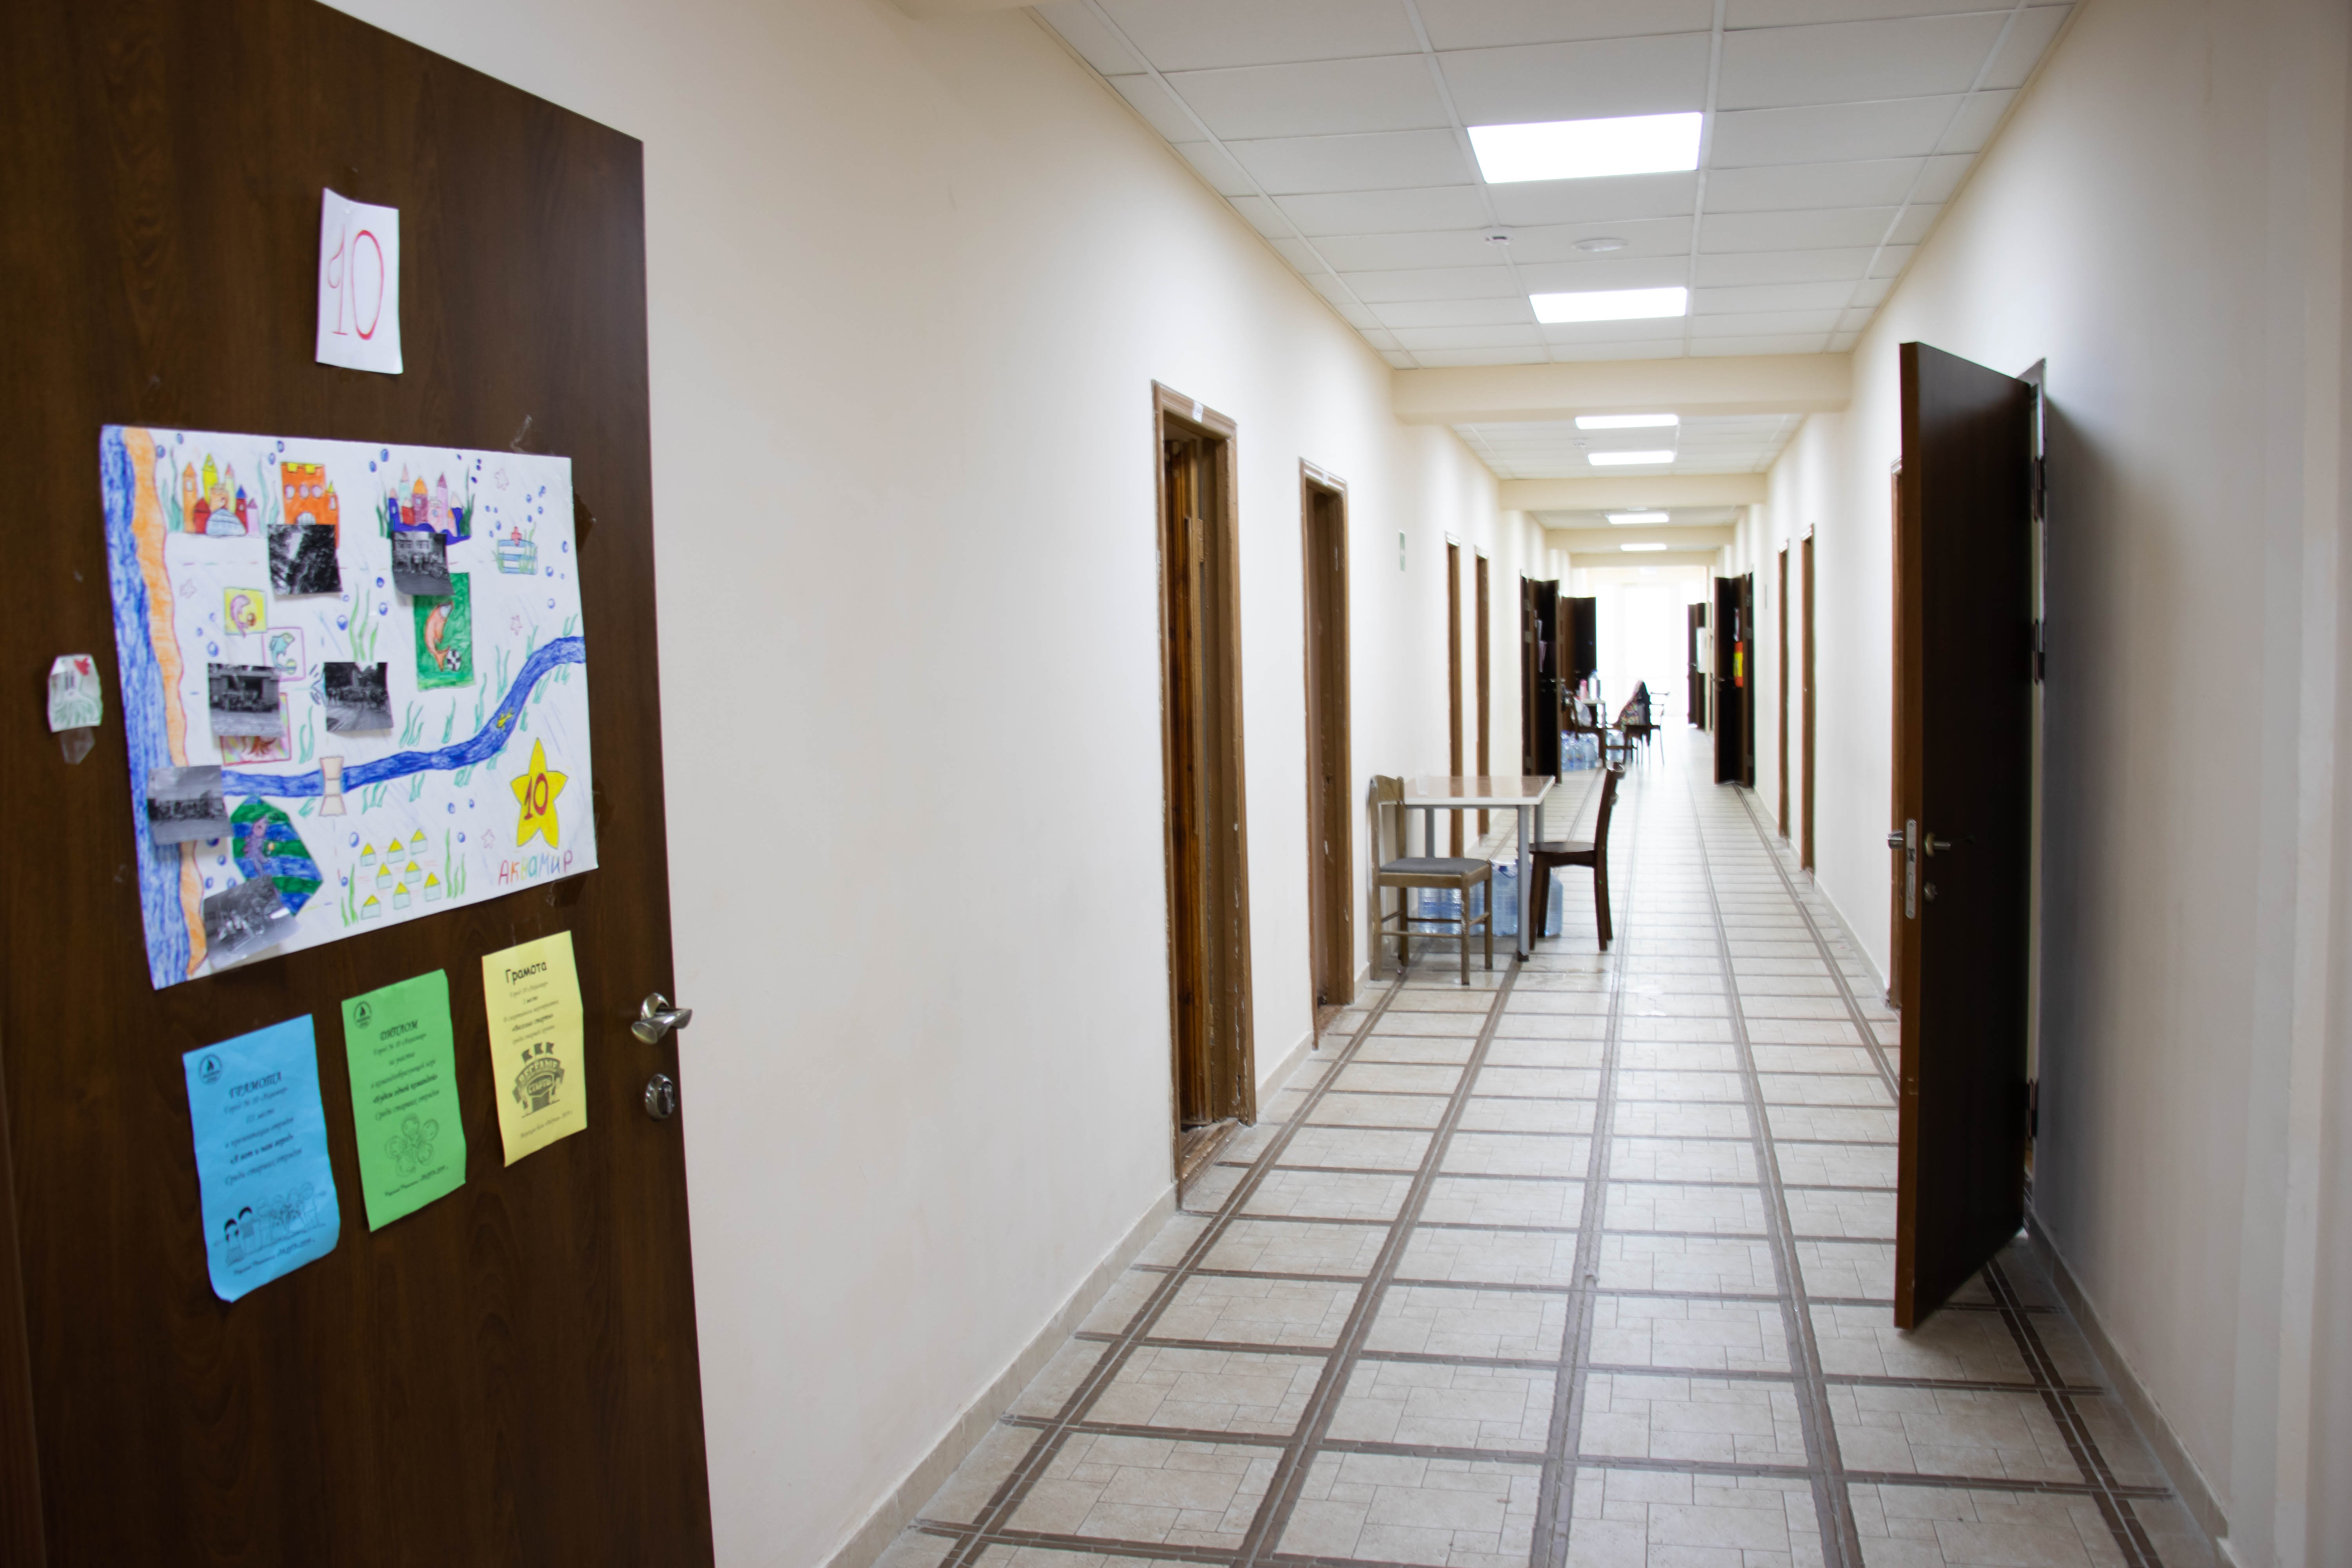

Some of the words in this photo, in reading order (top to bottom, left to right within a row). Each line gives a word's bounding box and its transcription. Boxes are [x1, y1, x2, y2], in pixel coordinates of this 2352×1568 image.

[328, 224, 384, 341] 10
[524, 773, 549, 820] 10
[505, 962, 547, 985] Грамота
[229, 1071, 282, 1098] ГРАМОТА
